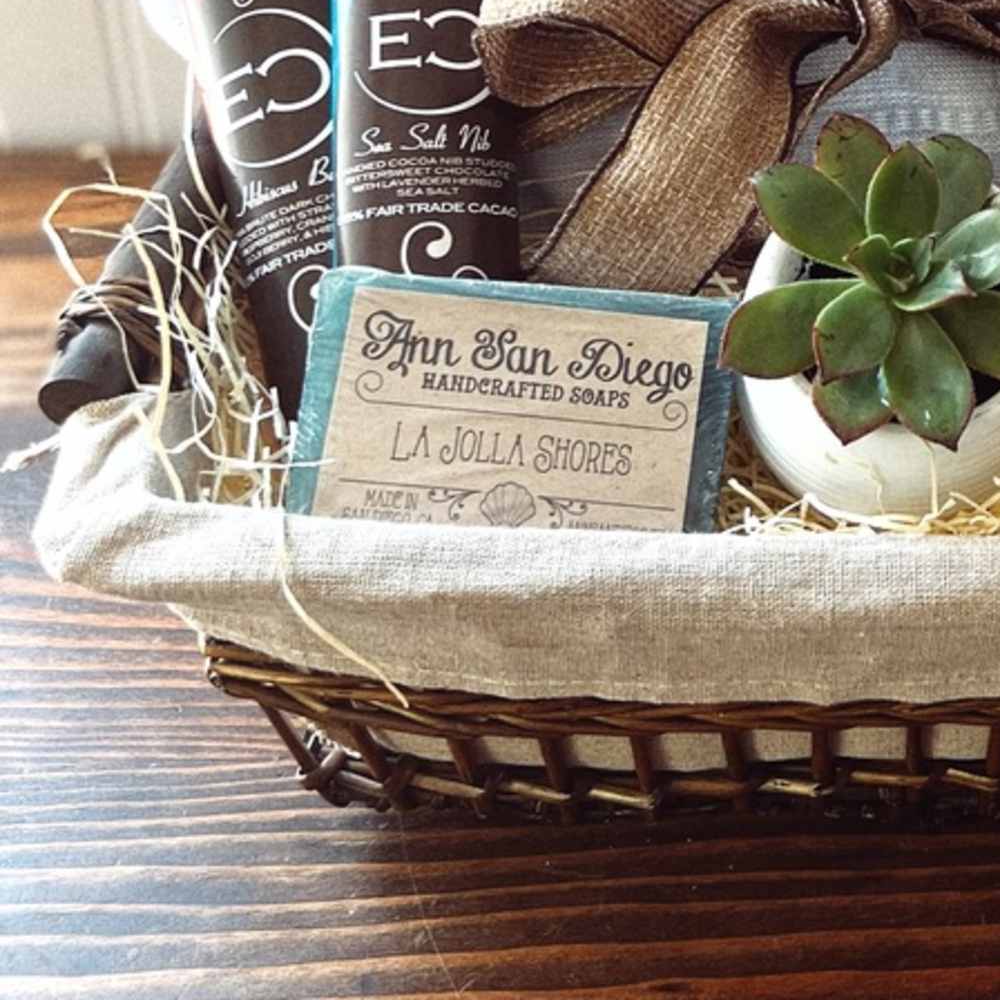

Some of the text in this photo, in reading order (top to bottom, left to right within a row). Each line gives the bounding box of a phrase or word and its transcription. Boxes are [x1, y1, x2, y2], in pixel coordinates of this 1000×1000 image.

[366, 202, 404, 219] FAIR
[407, 201, 465, 215] TRADE
[468, 202, 519, 218] CACAO
[396, 187, 460, 198] SEA SALT
[361, 309, 695, 404] Ann San Diego
[422, 371, 631, 410] HANDCRAFTED SOAPS
[390, 421, 633, 476] LA JOLLA SHORES
